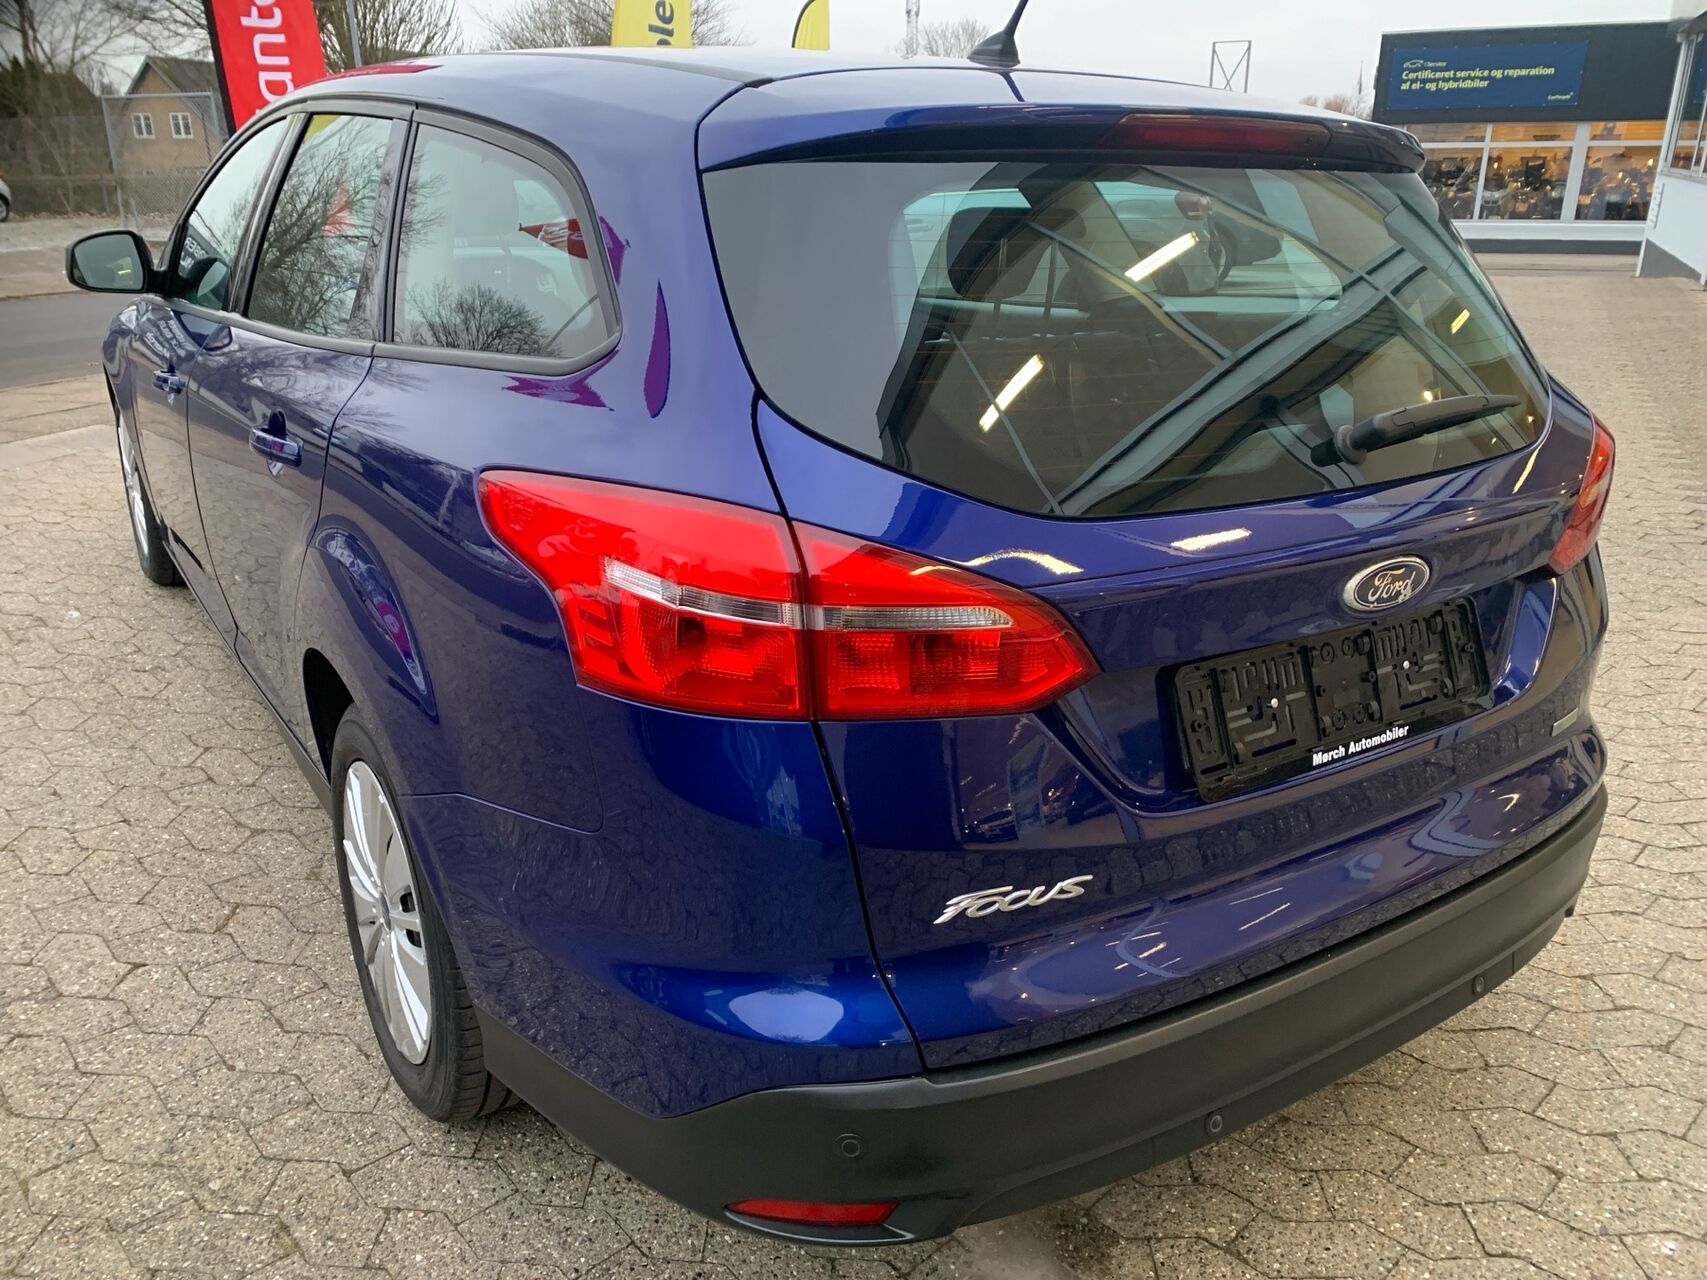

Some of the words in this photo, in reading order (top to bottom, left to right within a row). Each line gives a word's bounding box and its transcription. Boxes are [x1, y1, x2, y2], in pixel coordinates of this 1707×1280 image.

[240, 0, 295, 115] ant
[1402, 69, 1454, 80] Certificeret
[1455, 67, 1489, 78] service
[1490, 68, 1503, 79] og
[1504, 65, 1555, 78] reparation
[1438, 79, 1490, 91] hybridbiler
[1368, 567, 1416, 602] Ford
[1312, 745, 1346, 766] Mørch
[1348, 725, 1409, 754] Automobiler
